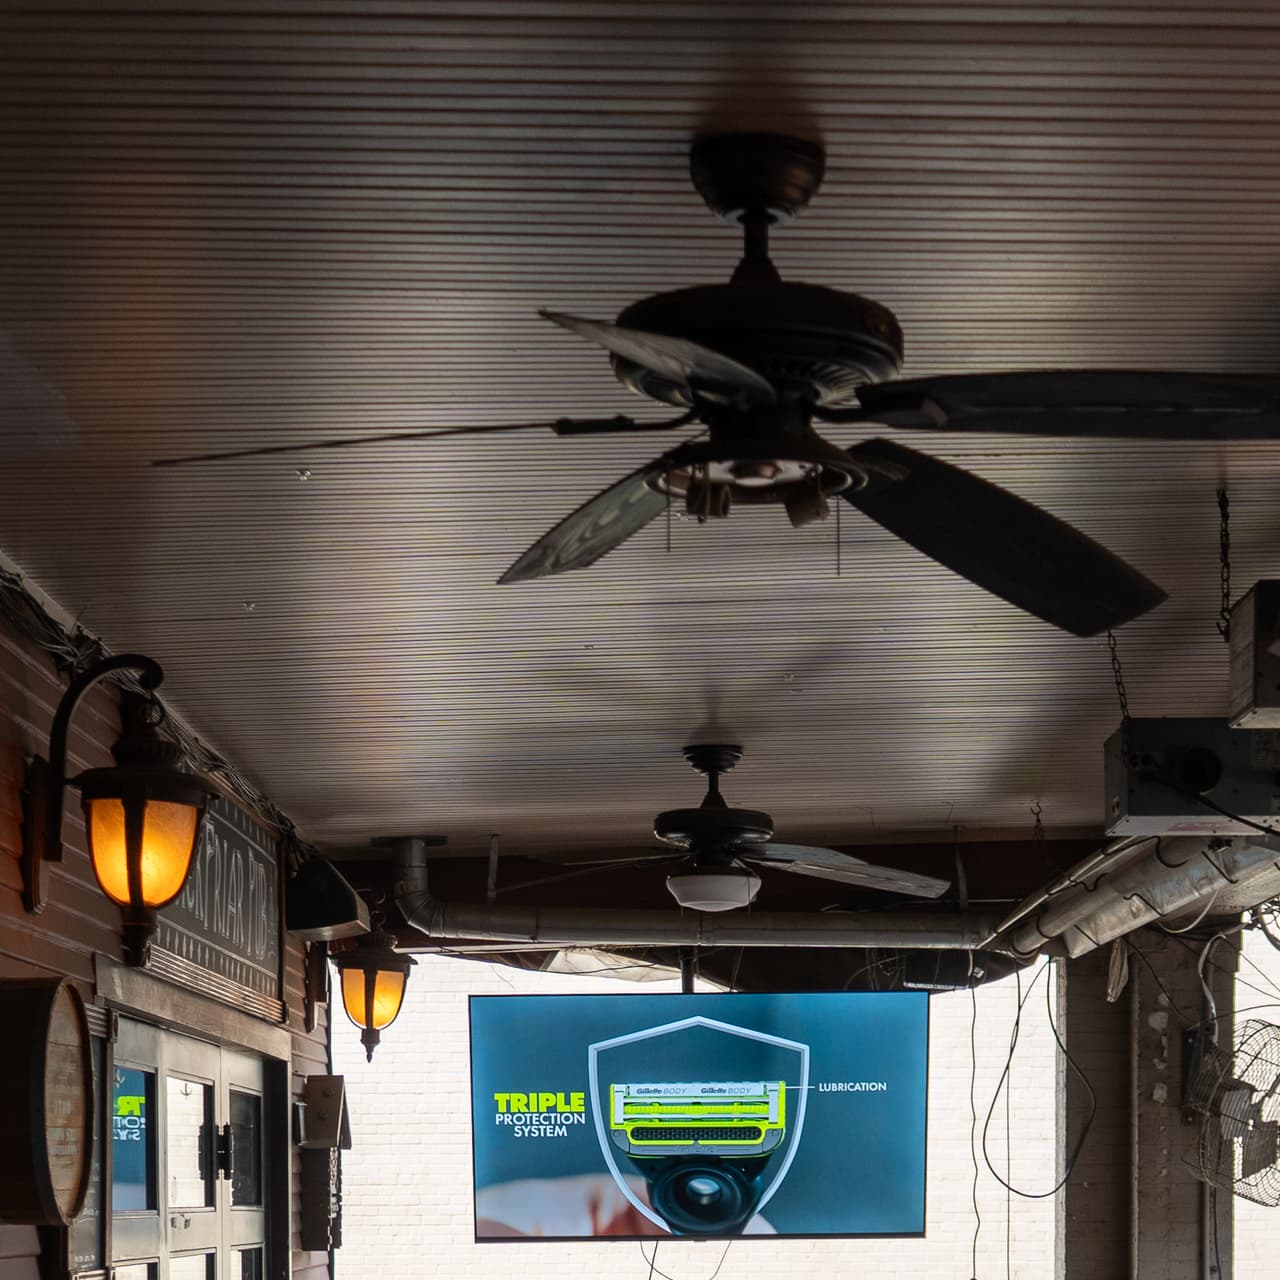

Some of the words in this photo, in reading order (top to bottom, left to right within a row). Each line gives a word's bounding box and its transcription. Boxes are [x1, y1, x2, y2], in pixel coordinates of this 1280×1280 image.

[819, 1082, 887, 1092] LUBRICATION
[494, 1092, 585, 1113] TRIPLE
[495, 1112, 586, 1125] PROTECTION
[513, 1125, 568, 1137] SYSTEM
